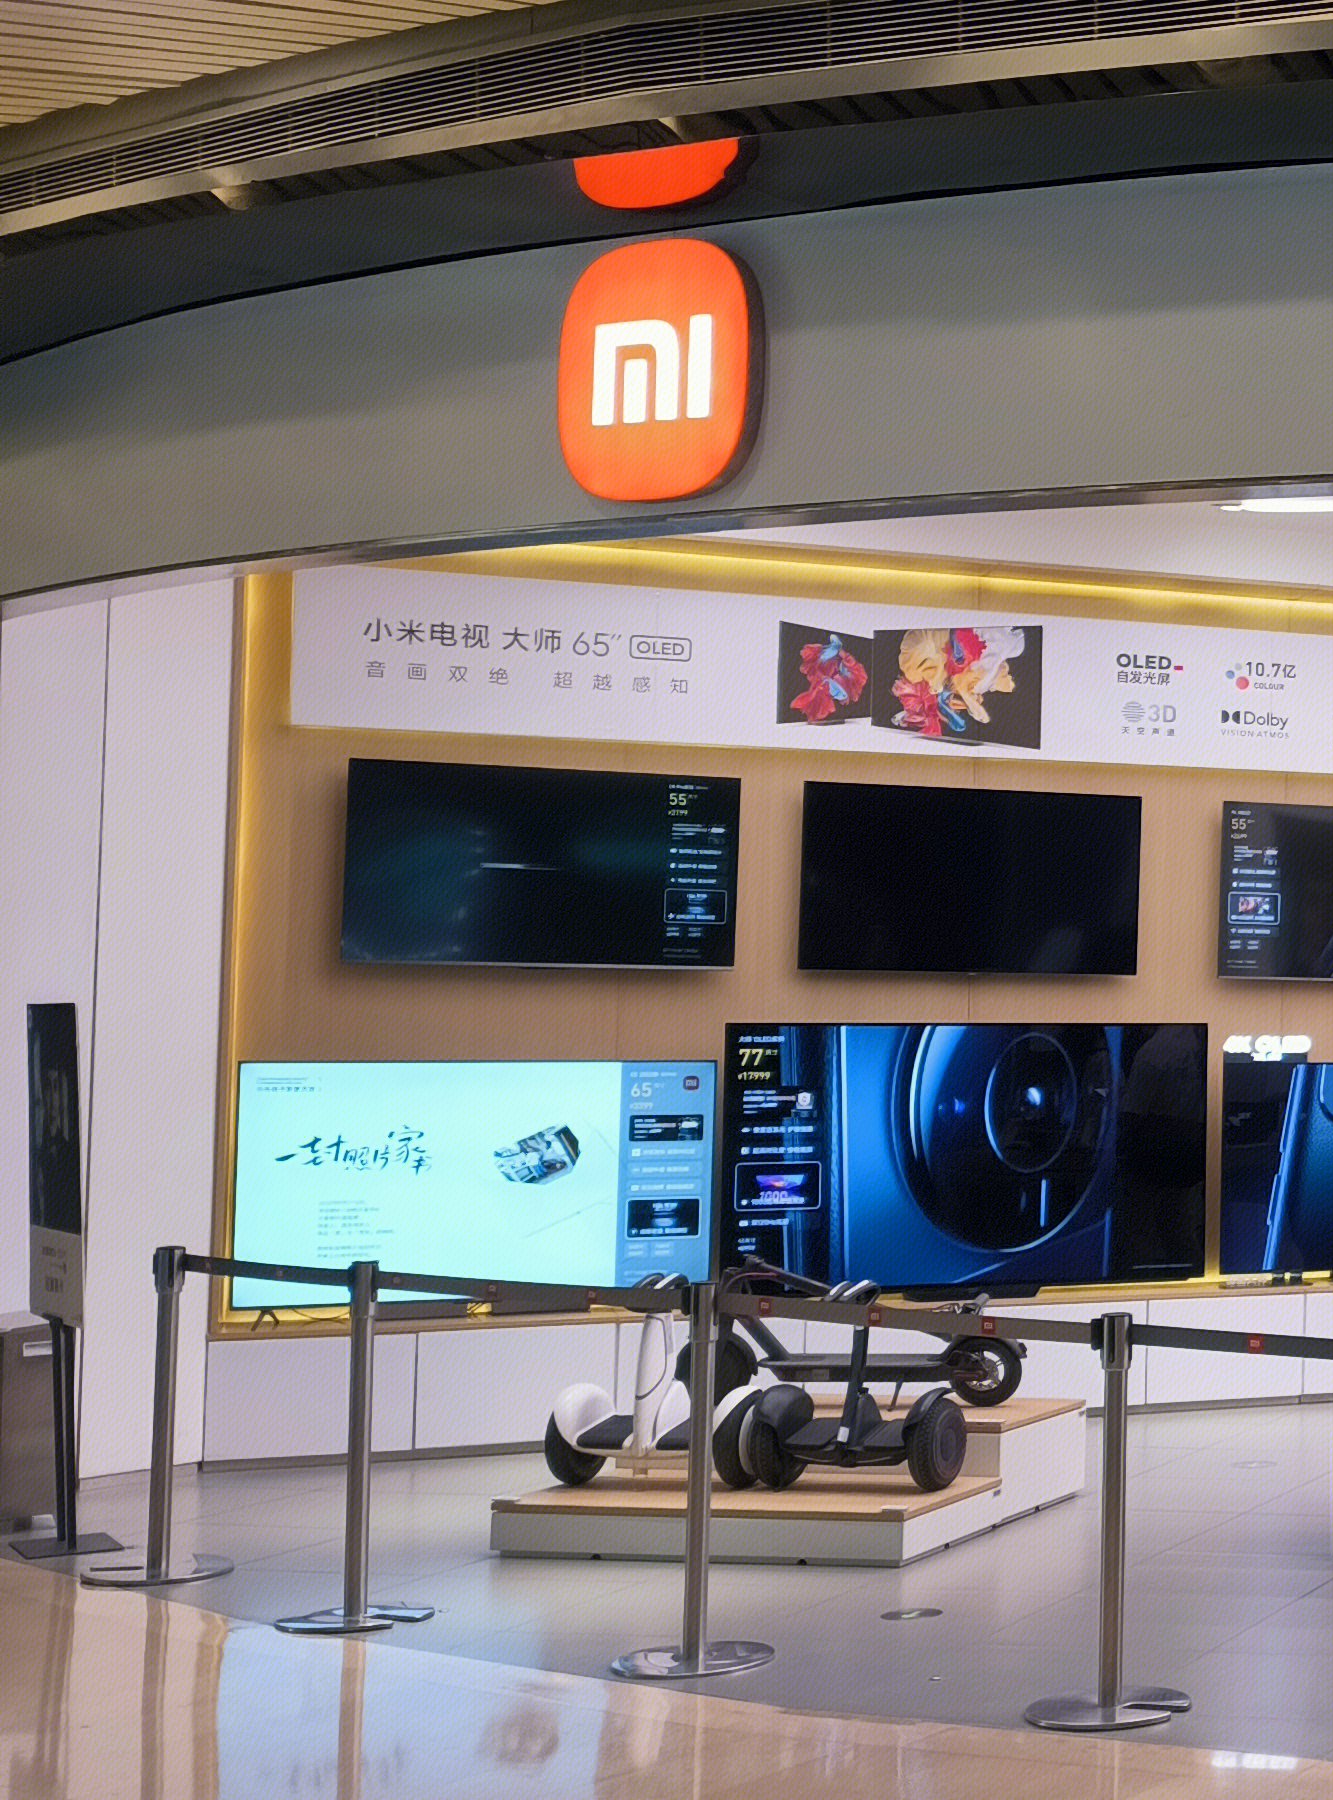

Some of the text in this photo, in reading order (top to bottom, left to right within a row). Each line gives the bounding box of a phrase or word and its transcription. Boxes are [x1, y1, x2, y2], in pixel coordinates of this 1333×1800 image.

[362, 617, 490, 650] 小米电视
[502, 627, 563, 653] 大师
[636, 639, 686, 657] OLED
[1115, 653, 1172, 671] OLED
[1246, 661, 1297, 679] 10.7亿
[364, 660, 689, 694] 音画双绝 超越感知
[1116, 671, 1171, 686] 自发光屏
[1148, 703, 1178, 723] 3D
[1243, 711, 1289, 731] Dolby
[670, 793, 687, 806] 55
[1231, 818, 1247, 830] 55
[738, 1048, 764, 1067] 77
[631, 1081, 652, 1098] 65
